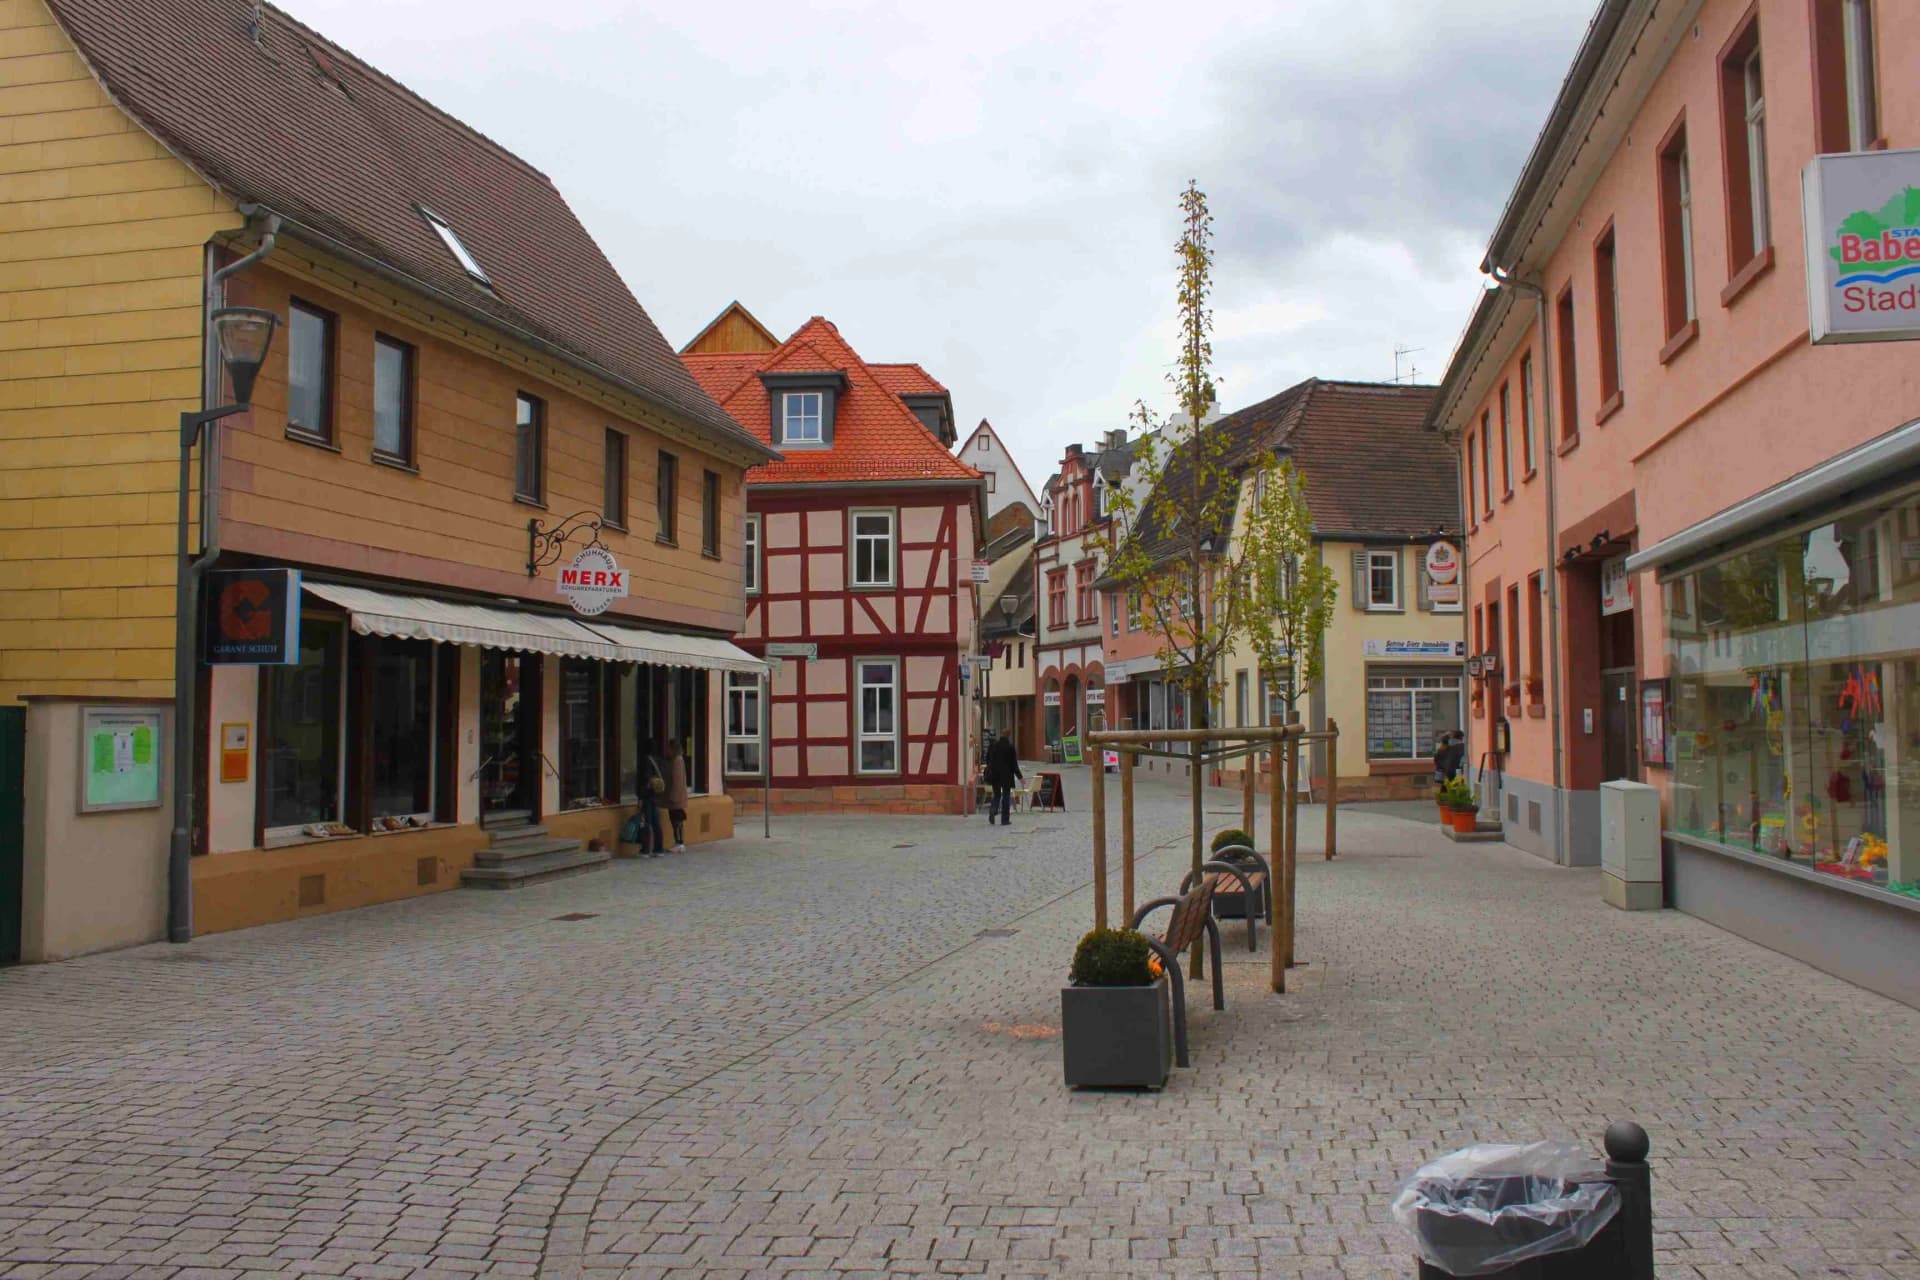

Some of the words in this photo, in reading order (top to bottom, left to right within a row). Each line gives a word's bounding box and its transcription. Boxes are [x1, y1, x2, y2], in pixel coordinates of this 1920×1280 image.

[1844, 284, 1920, 312] Stad
[573, 549, 613, 570] SCHUHHAUS
[562, 569, 622, 587] MERX
